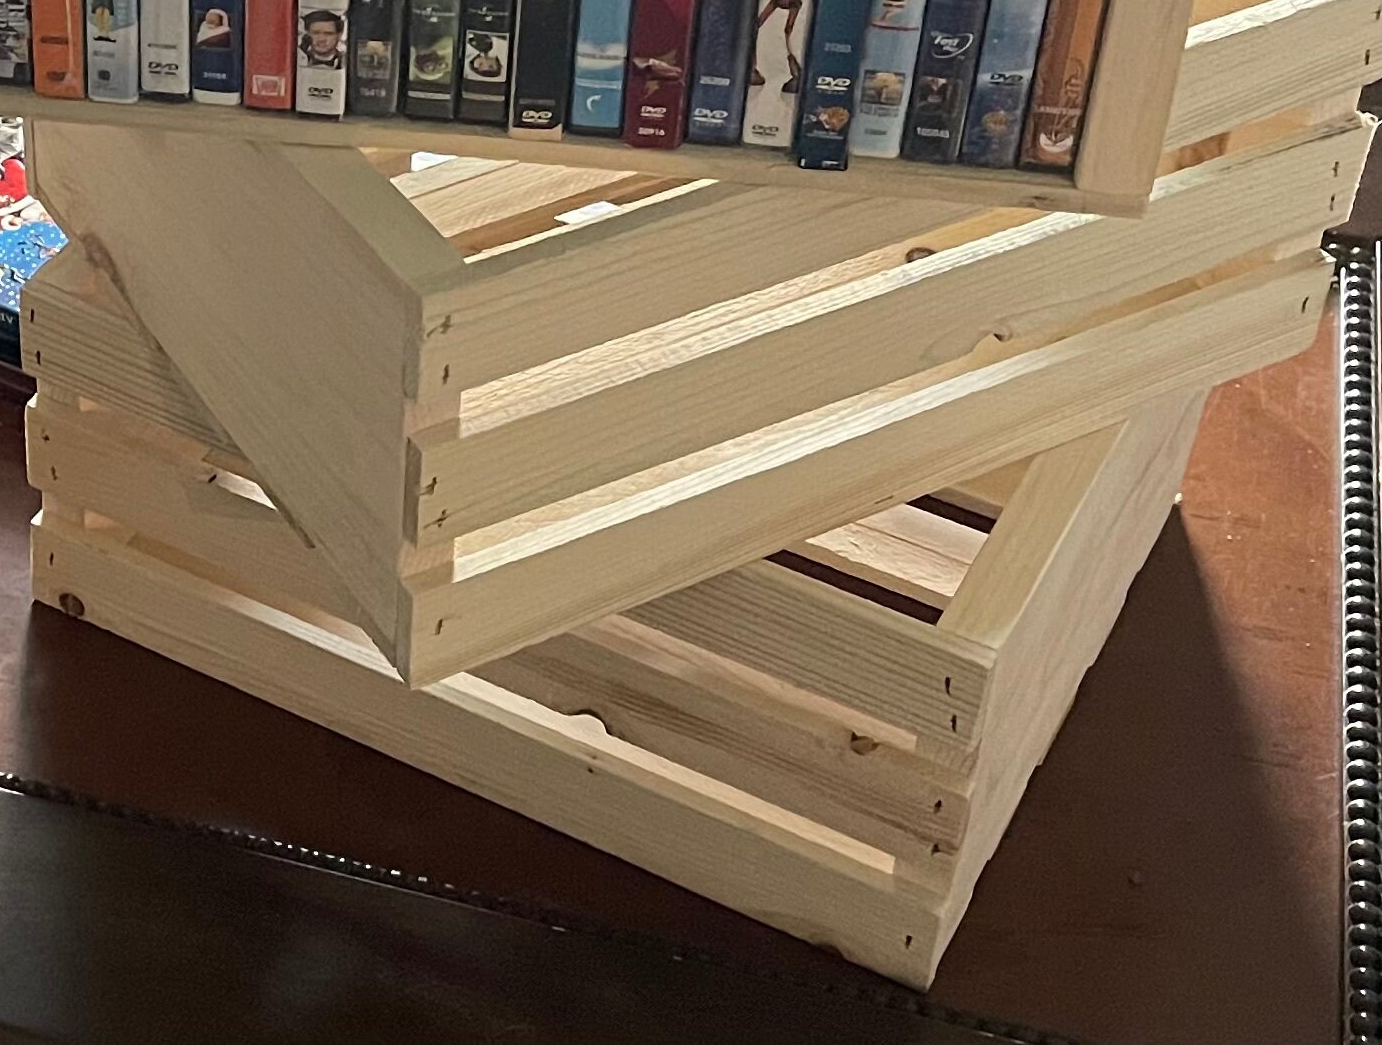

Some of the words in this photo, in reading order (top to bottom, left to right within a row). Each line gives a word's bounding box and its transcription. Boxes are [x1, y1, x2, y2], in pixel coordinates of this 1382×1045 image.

[146, 60, 180, 72] DVD
[816, 75, 853, 89] DVD
[989, 72, 1024, 84] DVD
[521, 109, 554, 121] DVD
[640, 105, 668, 115] DVD
[691, 107, 730, 121] DVD
